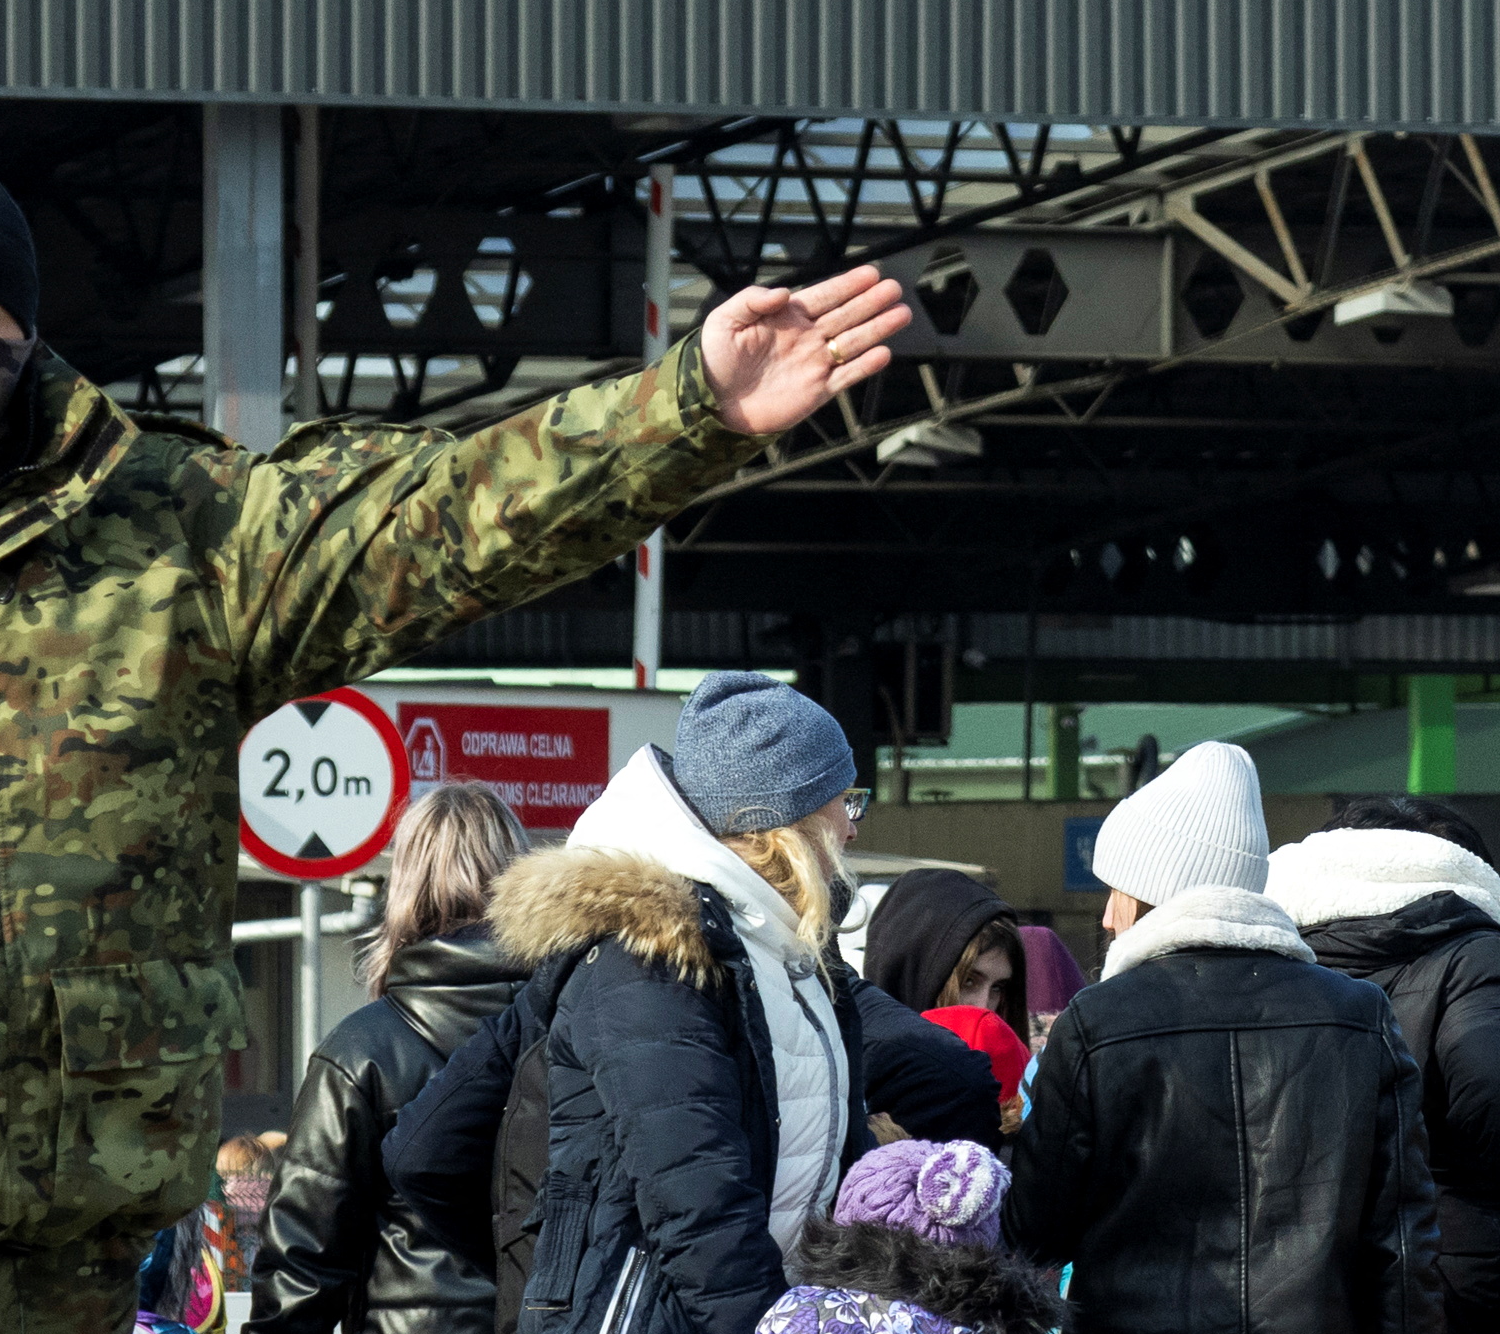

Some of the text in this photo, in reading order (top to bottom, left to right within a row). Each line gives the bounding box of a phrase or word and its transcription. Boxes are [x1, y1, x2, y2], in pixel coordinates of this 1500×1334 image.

[462, 731, 574, 758] ODPRAWA CELNA
[526, 782, 602, 806] CLEARANCE
